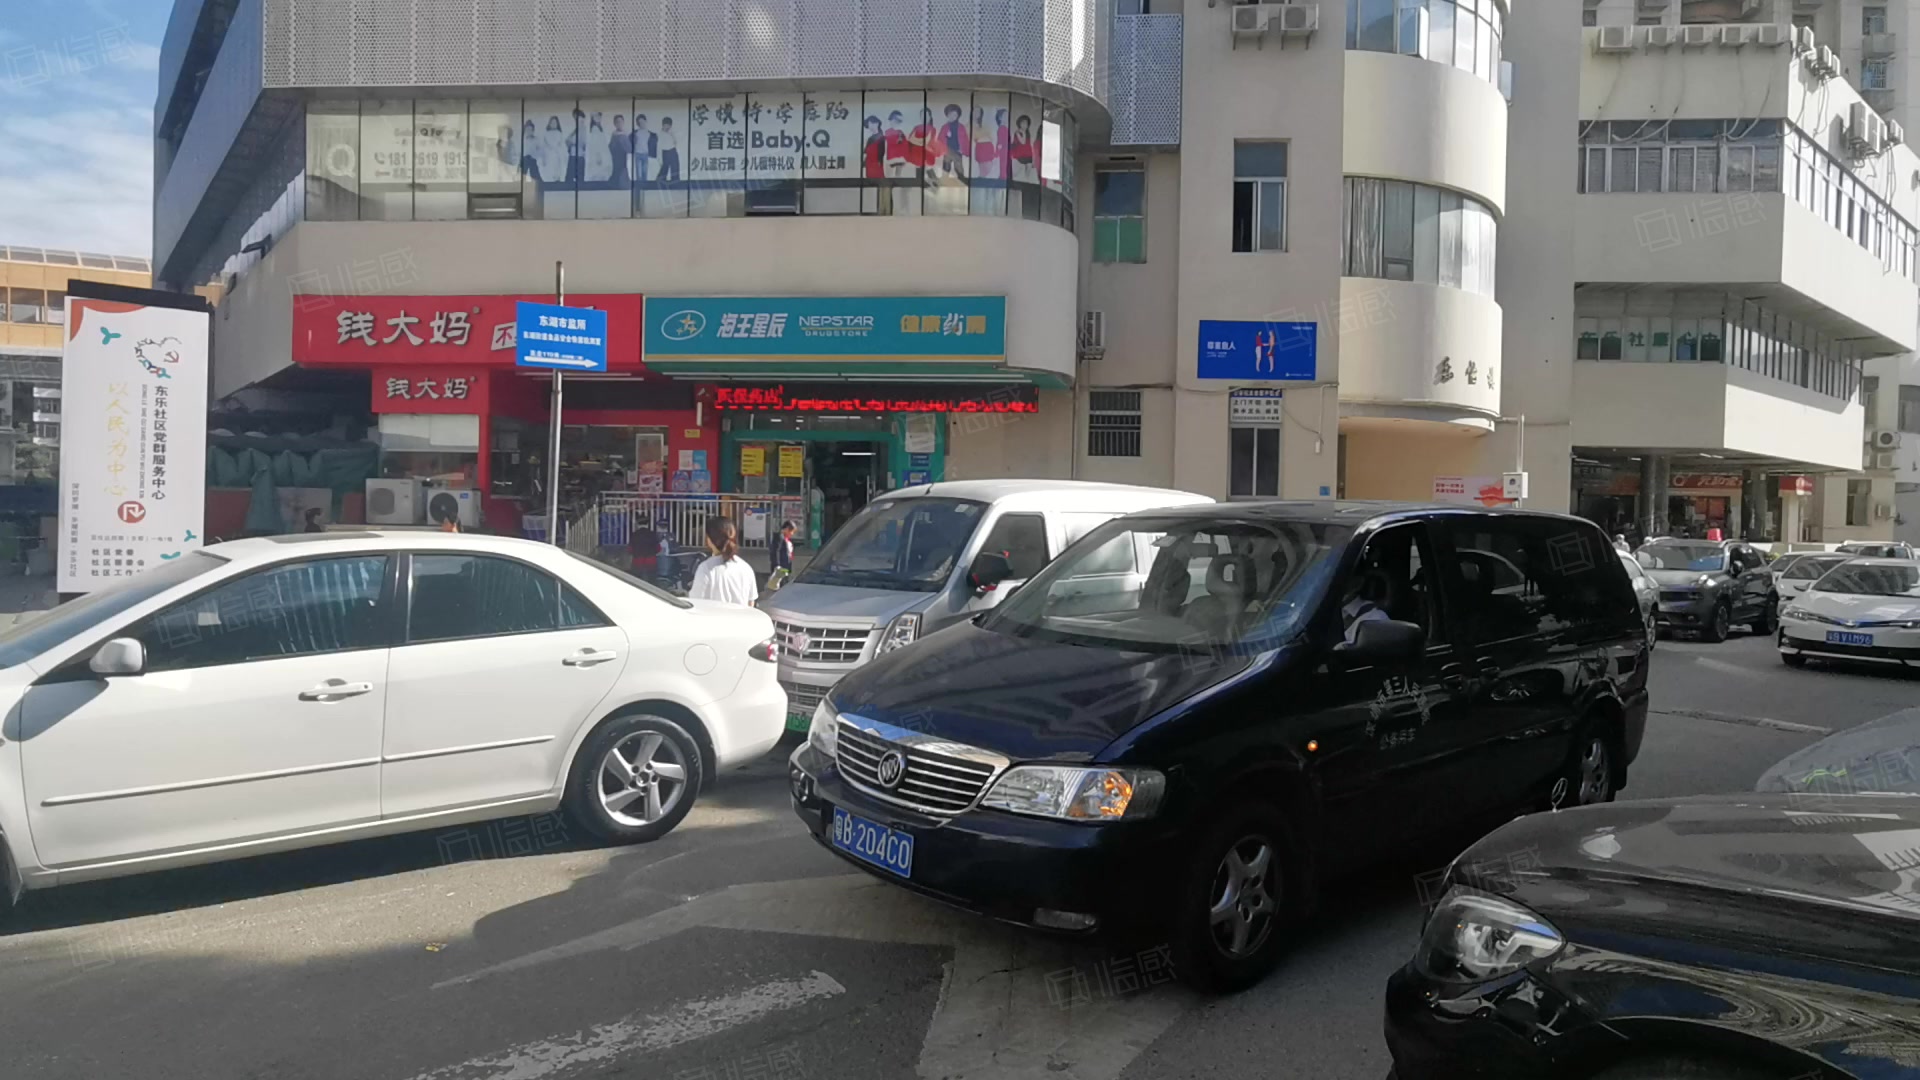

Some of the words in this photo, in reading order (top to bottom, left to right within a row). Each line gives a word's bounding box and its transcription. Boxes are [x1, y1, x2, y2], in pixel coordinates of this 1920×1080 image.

[706, 131, 745, 151] 首选
[751, 129, 831, 153] Baby.Q
[388, 151, 407, 166] 181
[413, 151, 439, 166] 619
[336, 309, 472, 347] 钱大妈
[538, 315, 587, 331] 东湖市监所
[716, 312, 789, 339] 海王星辰
[798, 315, 875, 327] NEPSTAR
[386, 377, 470, 401] 钱大妈
[104, 382, 131, 497] 以人民为中心
[151, 385, 169, 500] 东乐社区党群服务中心
[91, 569, 144, 577] 社区工作
